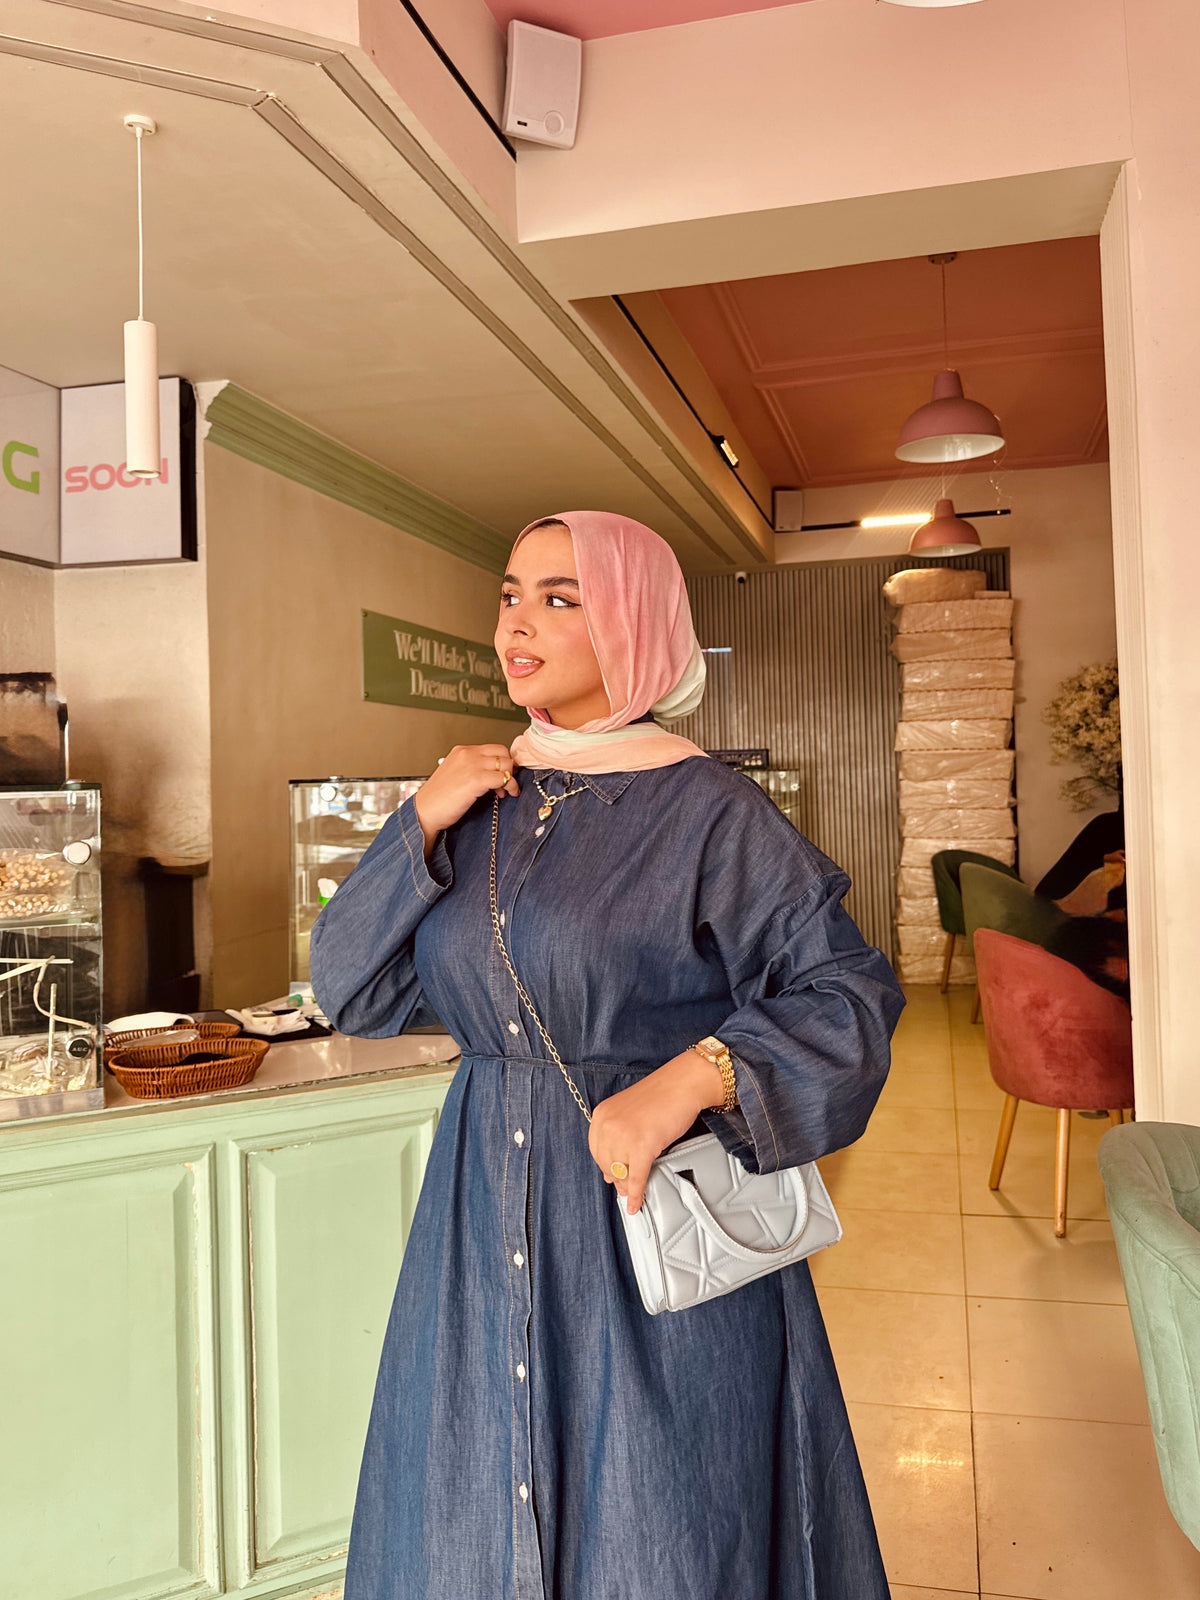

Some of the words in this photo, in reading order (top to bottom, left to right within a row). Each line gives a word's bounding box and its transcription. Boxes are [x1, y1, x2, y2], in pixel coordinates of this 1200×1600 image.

[393, 630, 431, 664] We'll
[432, 640, 466, 672] Make
[466, 650, 492, 679] Your
[409, 667, 458, 702] Dreams
[458, 679, 490, 707] Come
